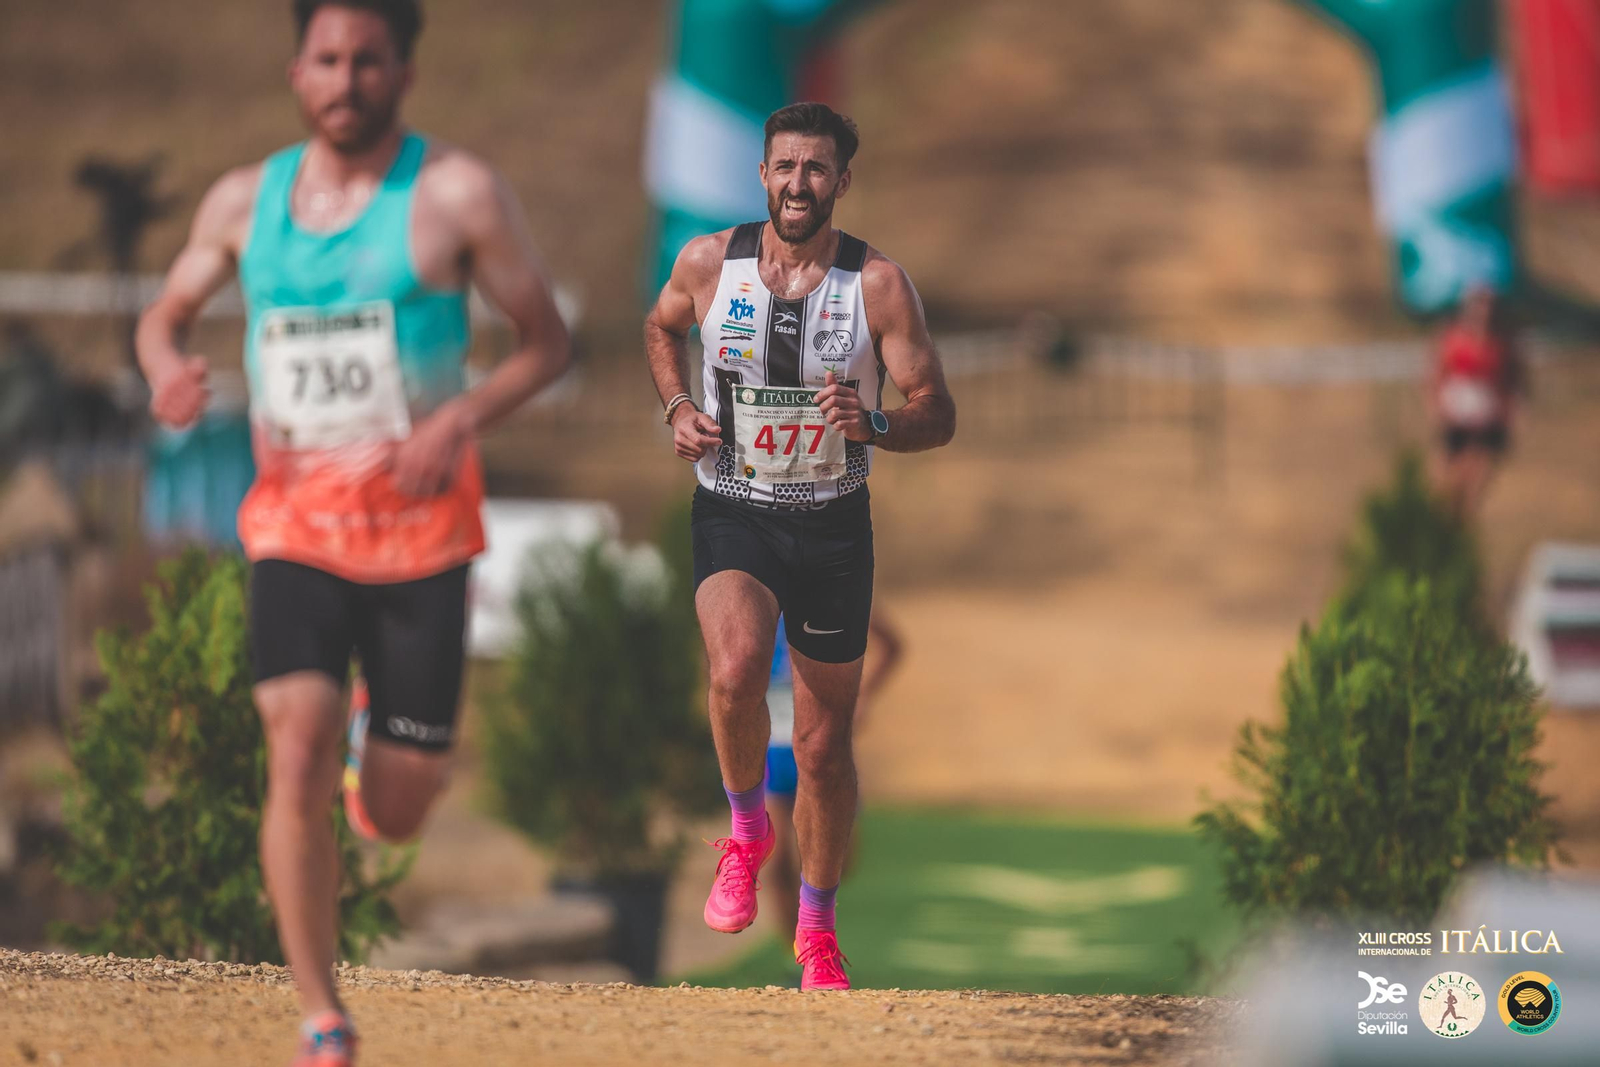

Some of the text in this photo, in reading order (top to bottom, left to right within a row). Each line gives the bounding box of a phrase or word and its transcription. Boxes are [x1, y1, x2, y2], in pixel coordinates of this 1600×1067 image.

[774, 324, 797, 335] rasán
[763, 391, 814, 404] ITÁLICA
[754, 424, 825, 455] 477
